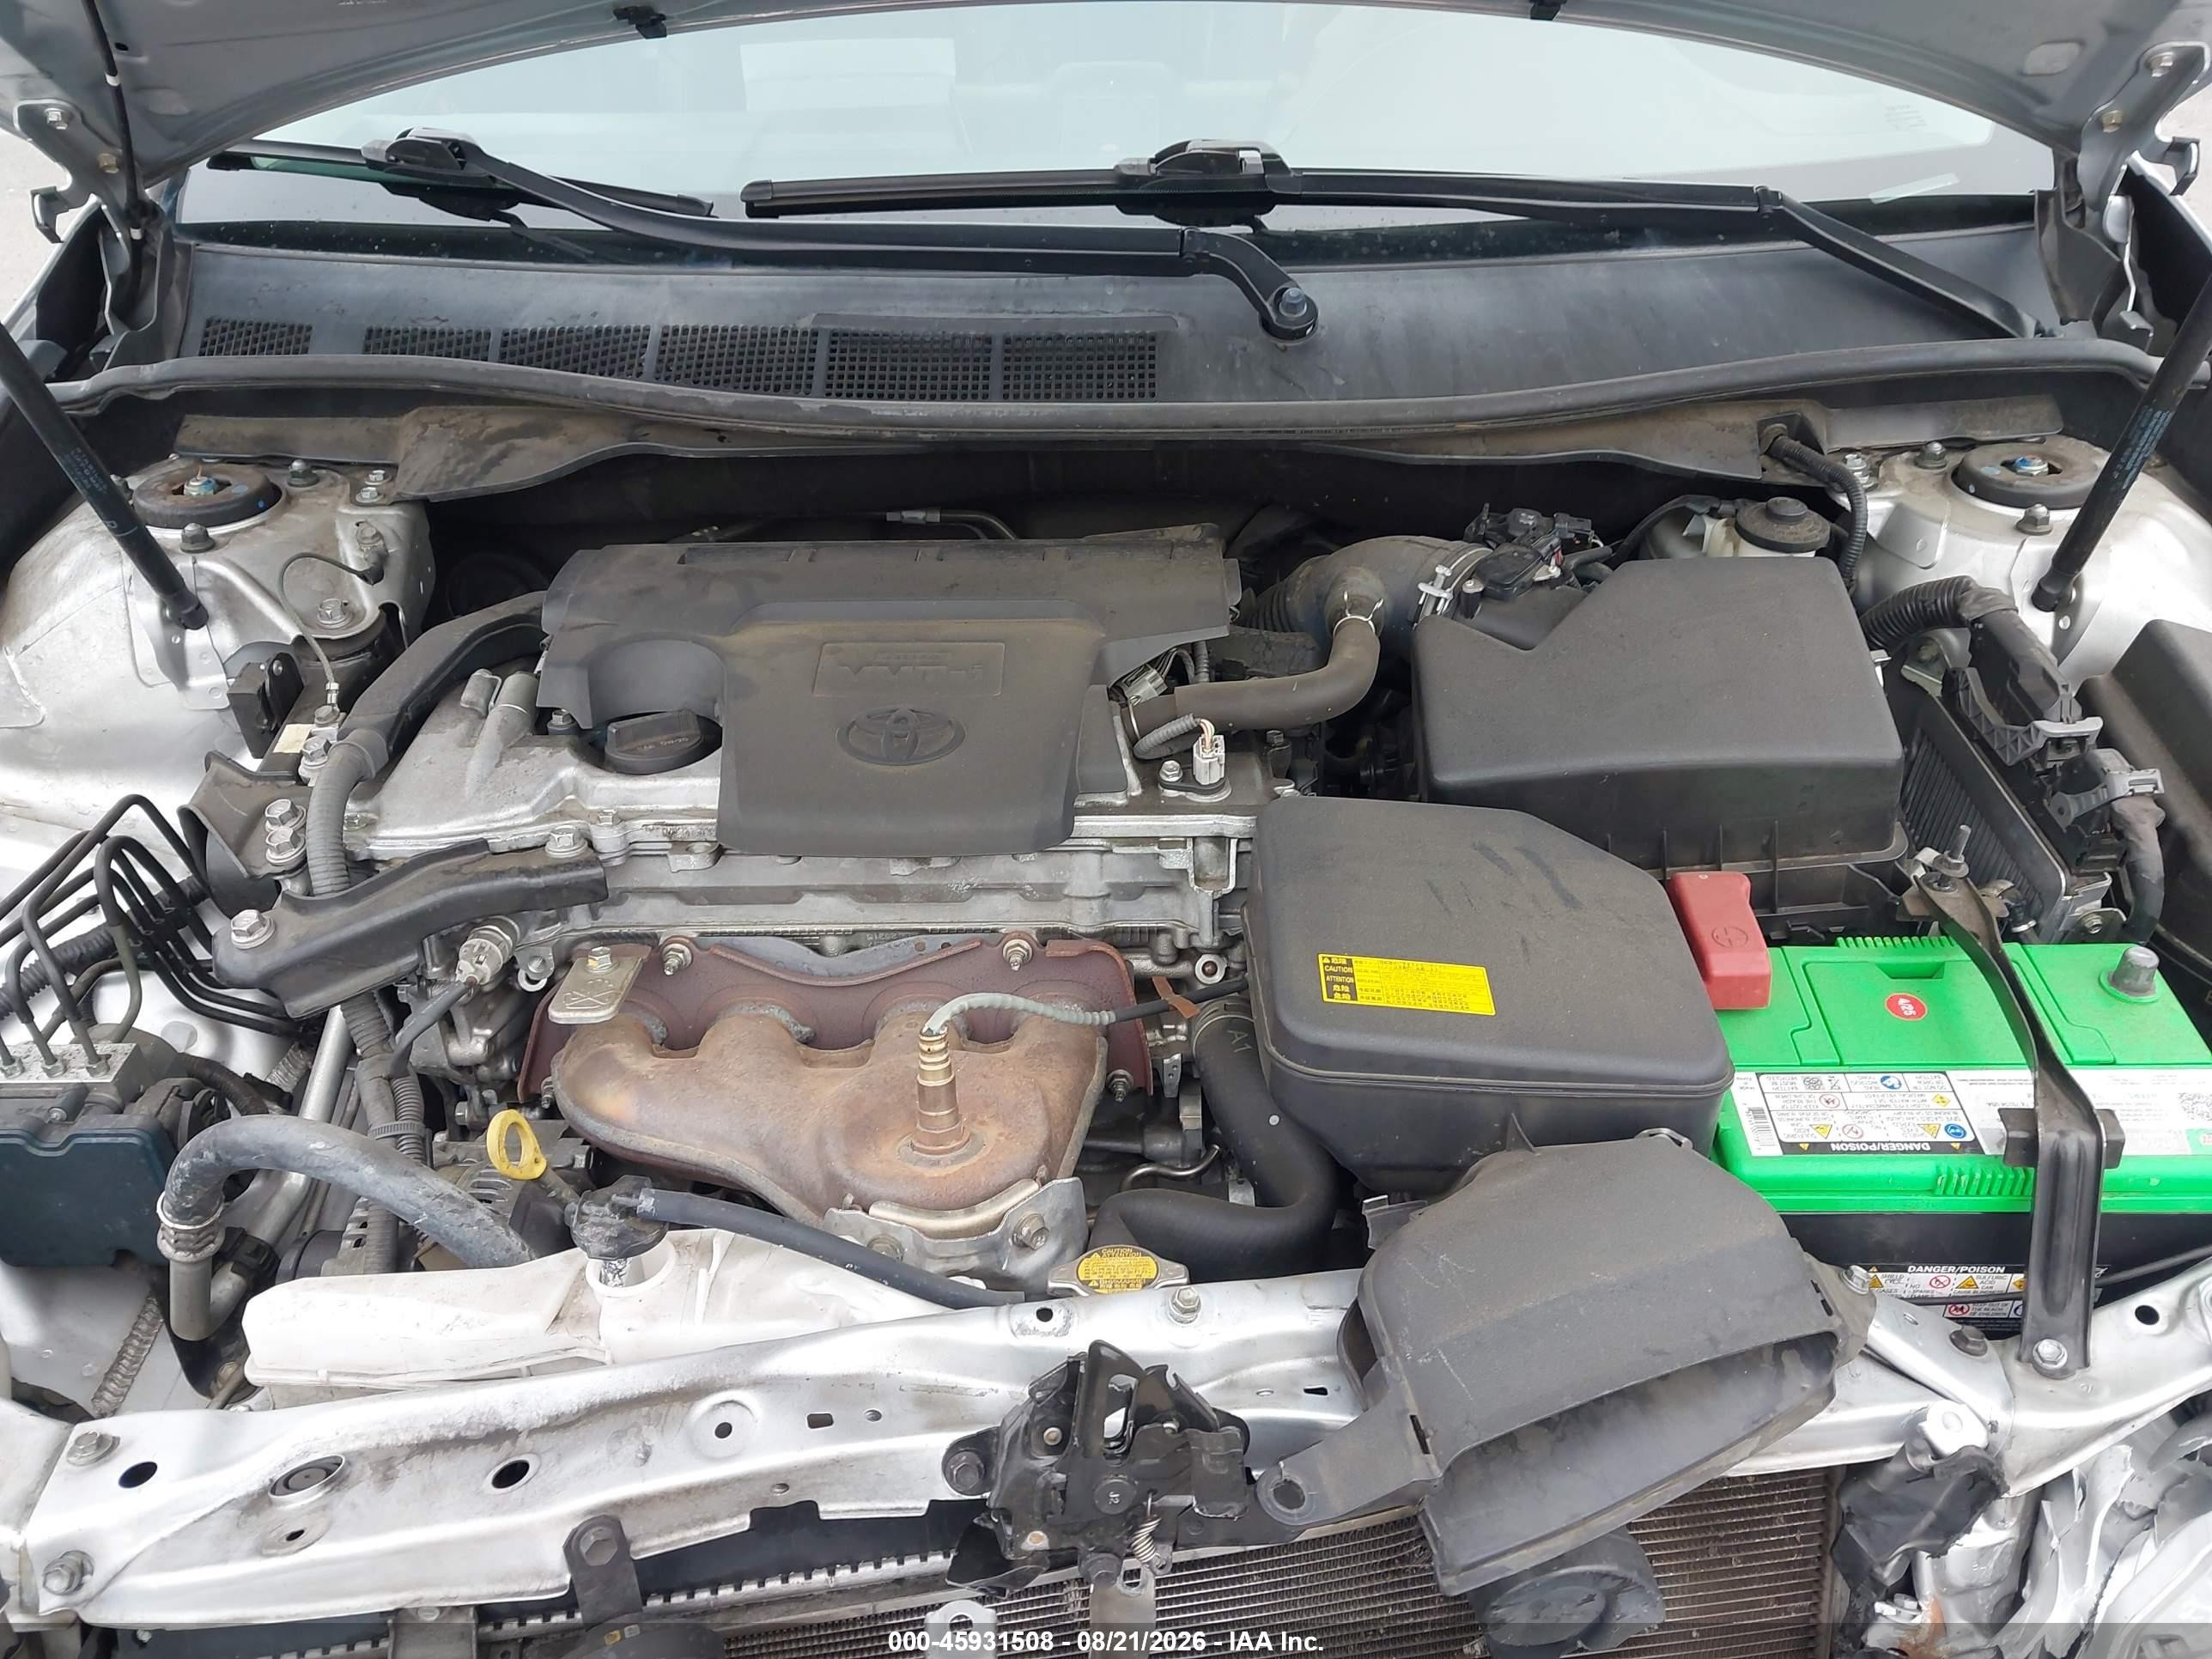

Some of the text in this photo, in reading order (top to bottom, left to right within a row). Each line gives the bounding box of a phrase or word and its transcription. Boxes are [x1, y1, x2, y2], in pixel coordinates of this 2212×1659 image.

[1324, 964, 1353, 974] CAUTION
[1326, 975, 1354, 984] ATTENTION
[1227, 1030, 1253, 1053] A1
[1831, 1142, 1931, 1152] DANGER/POISON
